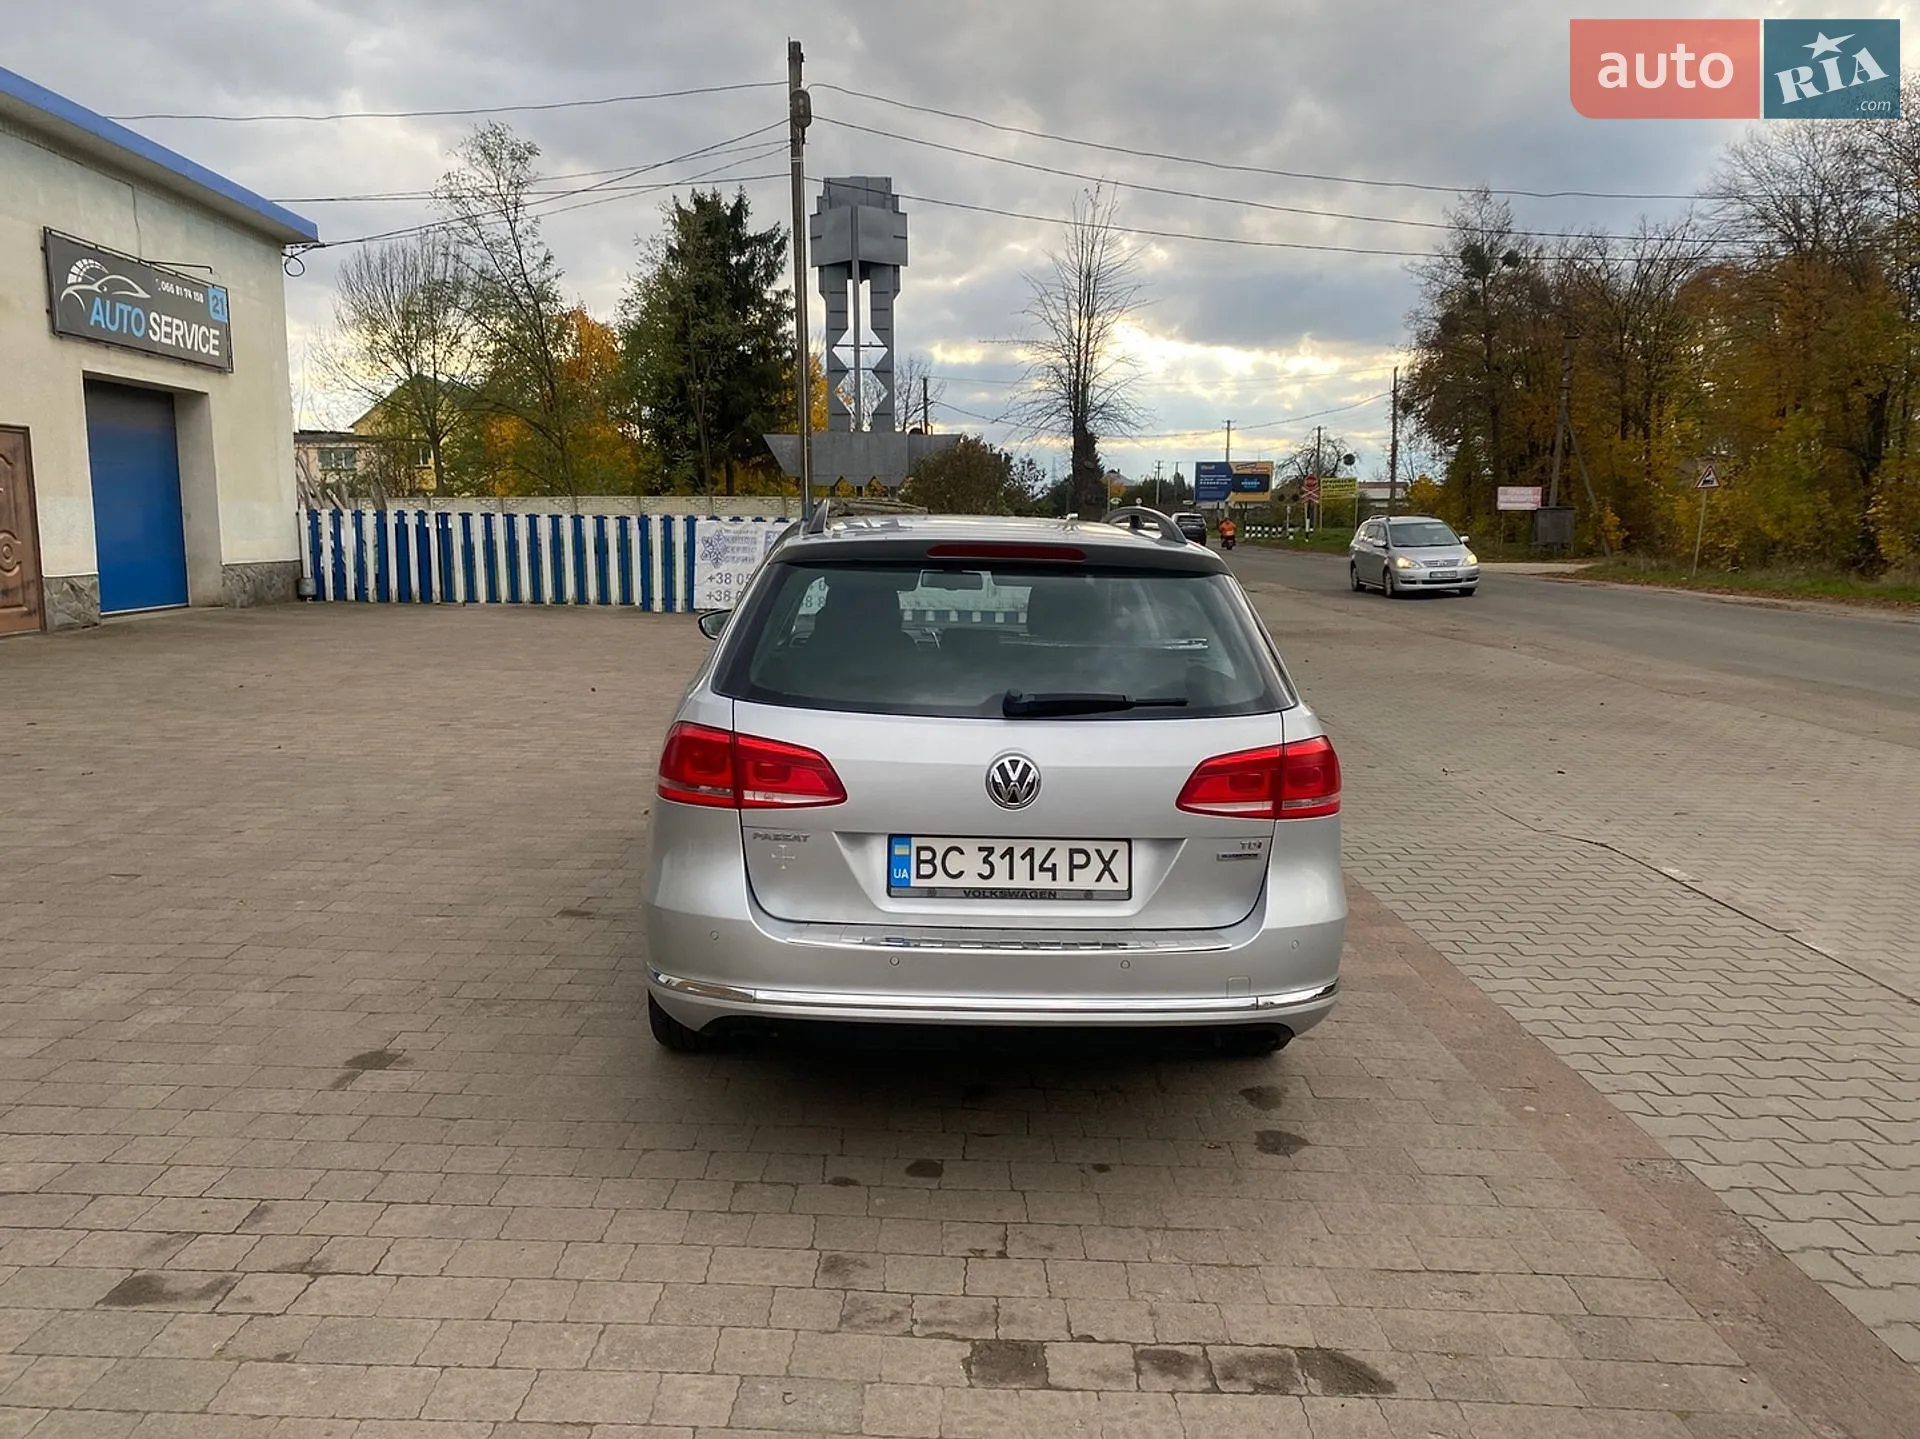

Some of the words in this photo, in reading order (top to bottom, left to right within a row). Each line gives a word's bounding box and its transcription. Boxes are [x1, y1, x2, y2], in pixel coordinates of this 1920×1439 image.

[212, 294, 224, 316] 21
[90, 296, 146, 338] AUTO
[148, 311, 220, 356] SERVICE
[707, 572, 732, 585] +38
[915, 845, 965, 880] BC
[977, 846, 1057, 882] 3114
[1068, 848, 1119, 883] PX
[893, 868, 908, 879] UA
[963, 889, 1057, 899] VOLKSWAGEN
